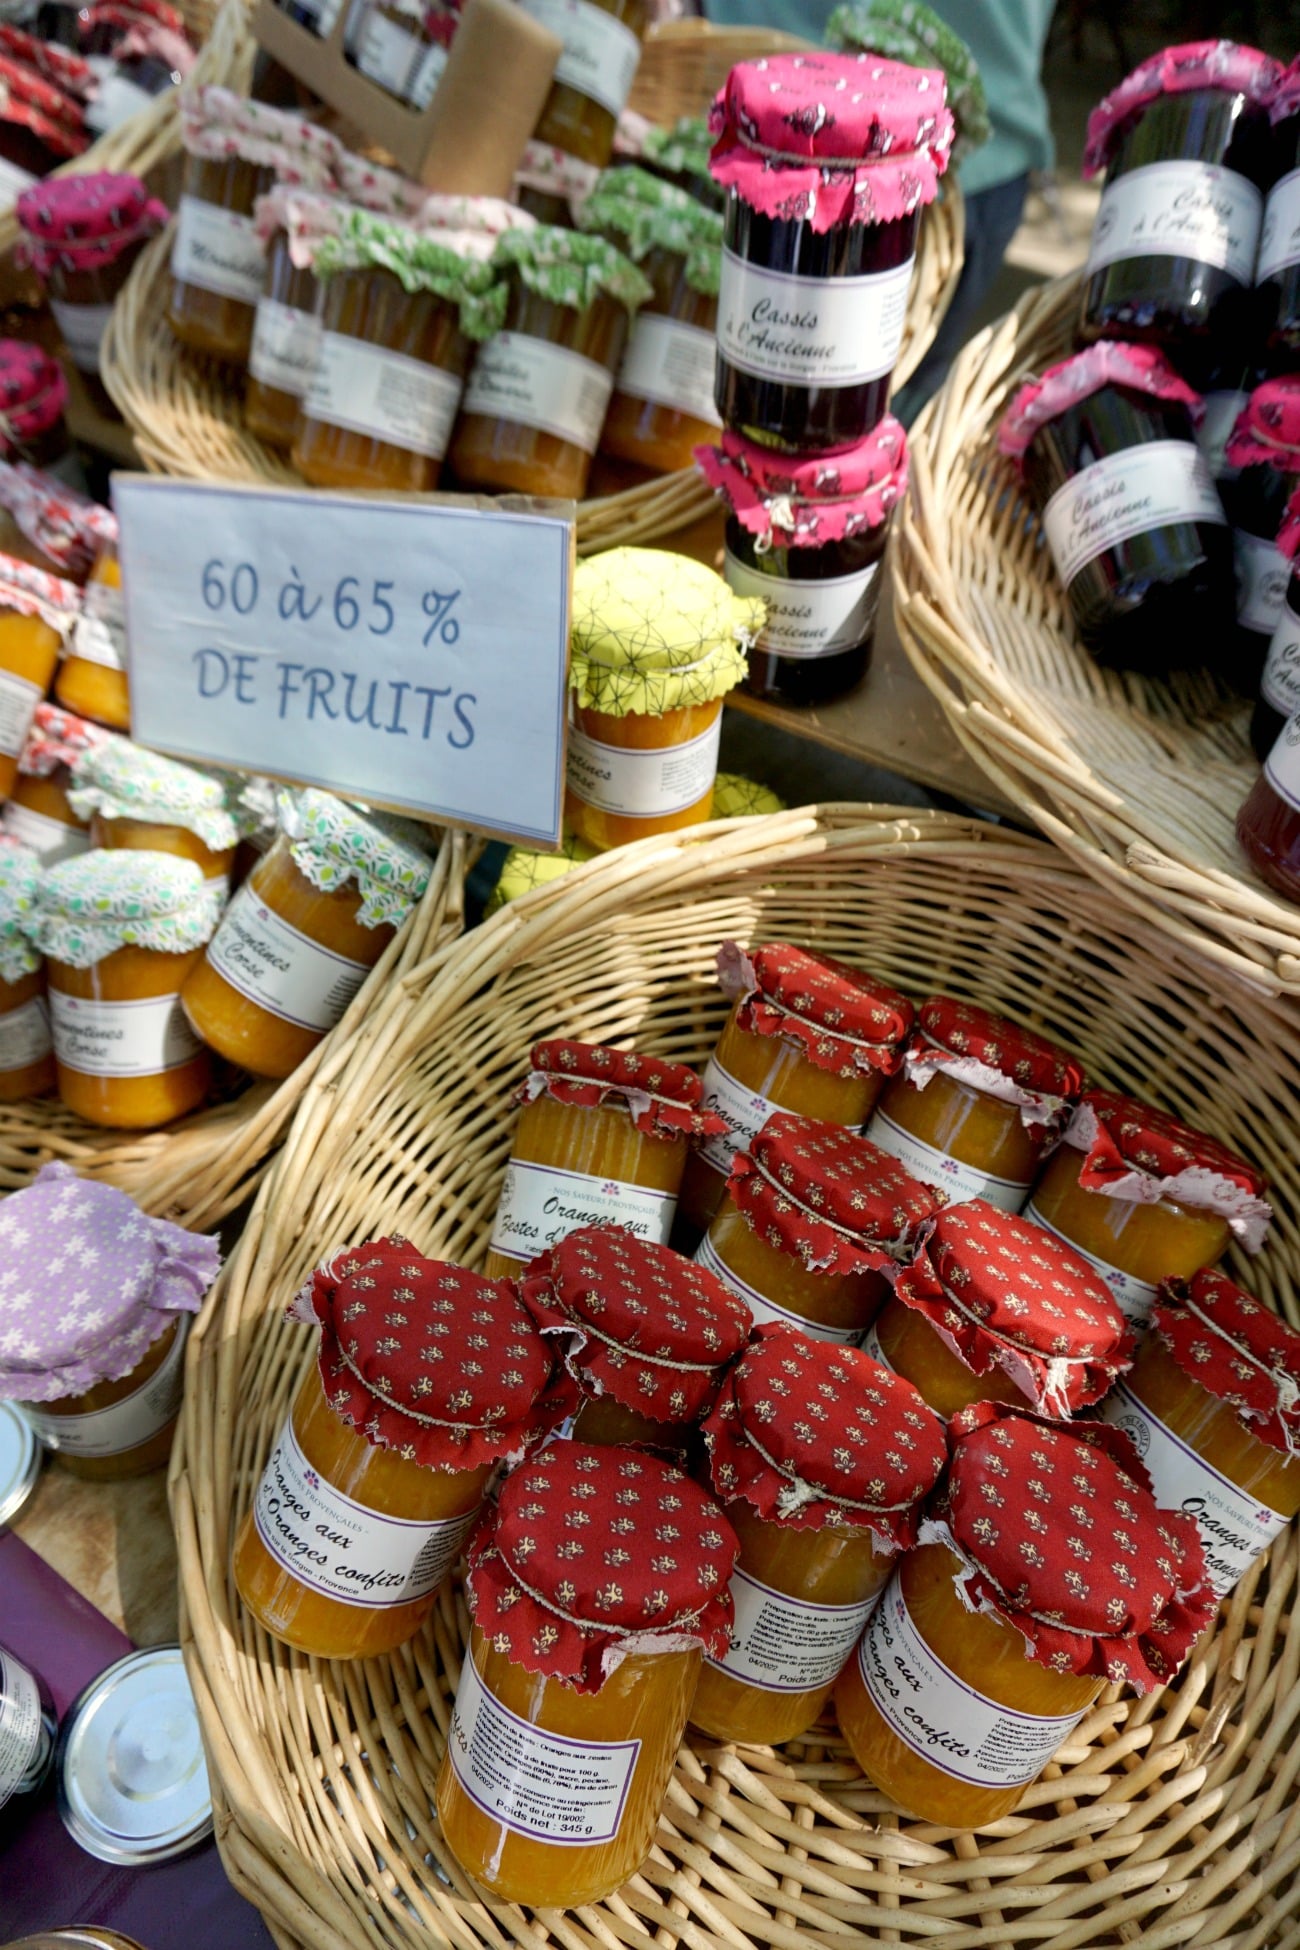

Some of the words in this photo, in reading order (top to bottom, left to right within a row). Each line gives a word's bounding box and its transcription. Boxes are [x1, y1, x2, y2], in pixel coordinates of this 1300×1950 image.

[752, 298, 819, 330] Cassis
[736, 324, 836, 360] l'Ancienne
[202, 558, 259, 616] 60
[277, 564, 324, 622] à
[333, 575, 395, 636] 65
[421, 588, 462, 648] %
[766, 625, 828, 639] ncienne
[191, 647, 260, 705] DE
[276, 661, 478, 750] FRUITS
[224, 942, 265, 979] Corse
[66, 1036, 109, 1058] Corse
[706, 1094, 759, 1139] Oranges
[572, 1190, 606, 1205] SAVEURS
[501, 1213, 539, 1238] Zestes
[542, 1196, 617, 1225] Oranges
[623, 1219, 651, 1235] aux
[272, 1448, 310, 1522] Oranges
[315, 1521, 354, 1550] aux
[305, 1488, 363, 1533] PROVENÇALES
[1203, 1490, 1223, 1508] NOS
[1226, 1506, 1254, 1530] SAVEURS
[1181, 1497, 1251, 1551] Oranges
[271, 1535, 281, 1546] sur
[288, 1552, 313, 1576] Sorgue
[318, 1574, 360, 1596] Provence
[334, 1564, 407, 1591] confits
[748, 1656, 779, 1671] 04/2022
[779, 1674, 807, 1684] Poids
[894, 1655, 924, 1692] aux
[889, 1706, 924, 1745] Provence
[903, 1704, 971, 1758] confits
[540, 1743, 572, 1758] Oranges
[471, 1764, 495, 1791] 04/2022
[559, 1767, 577, 1775] pour
[579, 1769, 593, 1777] 100
[512, 1789, 550, 1808] préférence
[522, 1787, 556, 1802] conserve
[496, 1798, 528, 1821] Poids
[530, 1816, 550, 1829] net
[560, 1823, 582, 1833] 345
[529, 1806, 540, 1815] de
[541, 1809, 556, 1819] Lot
[558, 1814, 586, 1823] 19/002
